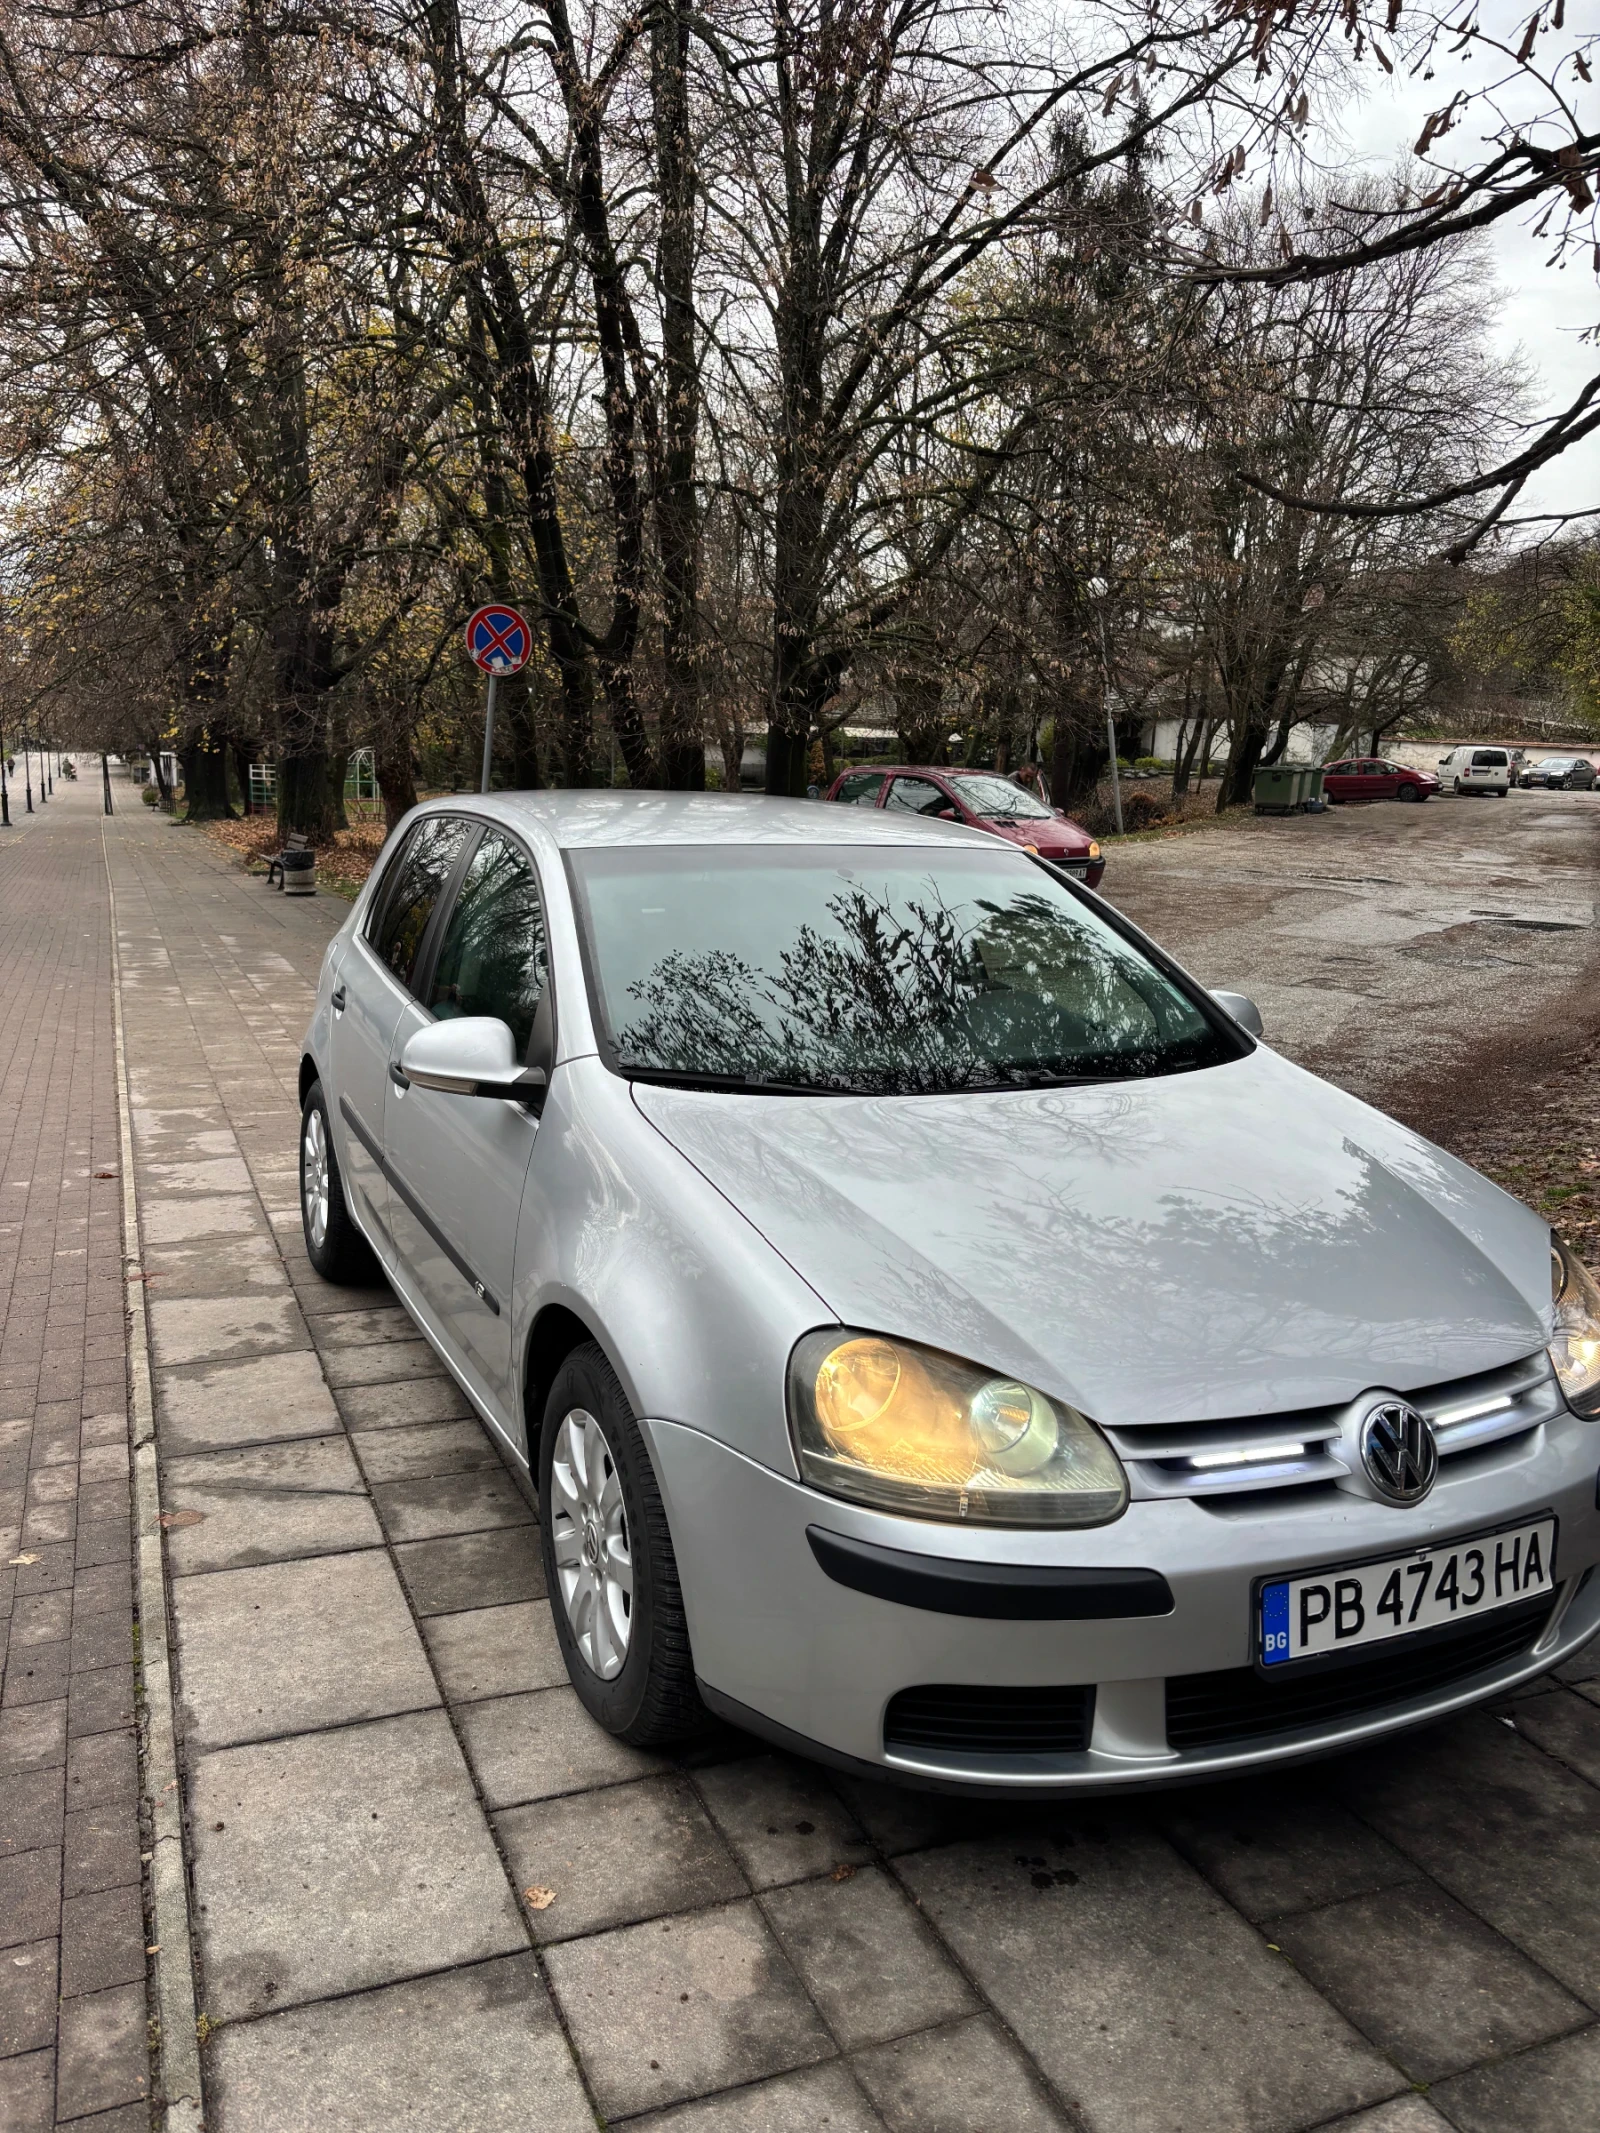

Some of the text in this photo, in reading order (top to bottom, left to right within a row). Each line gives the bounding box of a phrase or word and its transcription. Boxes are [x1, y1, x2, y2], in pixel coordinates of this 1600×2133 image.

[1299, 1531, 1545, 1647] PB 4743 HA
[1265, 1631, 1287, 1652] BG
